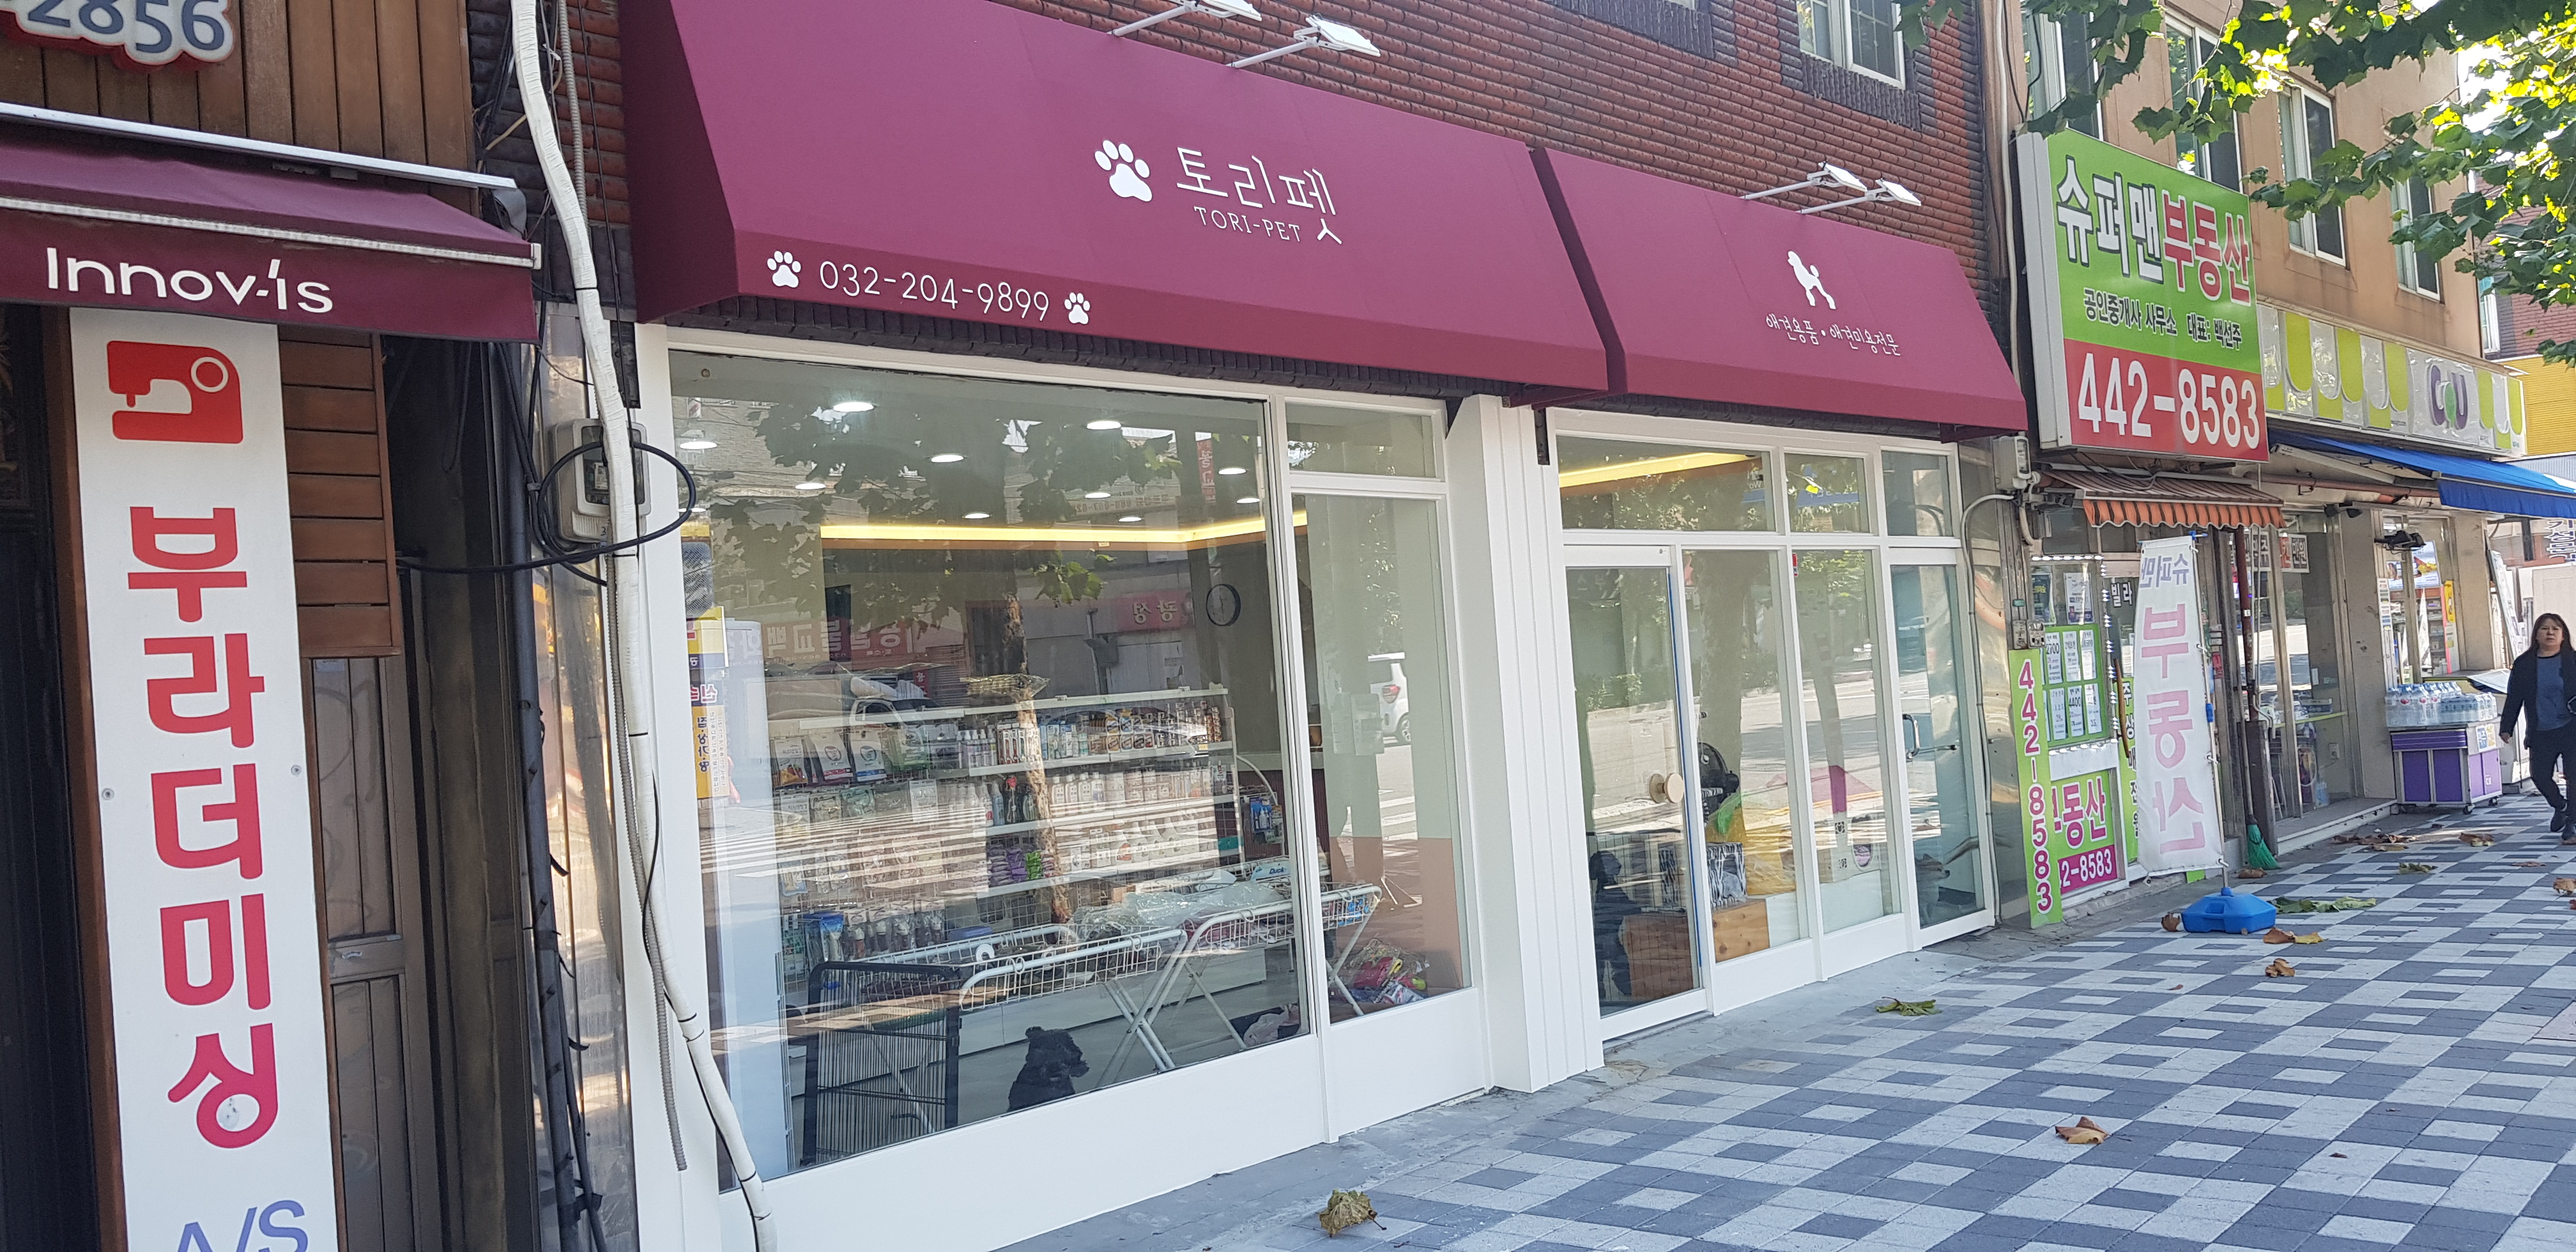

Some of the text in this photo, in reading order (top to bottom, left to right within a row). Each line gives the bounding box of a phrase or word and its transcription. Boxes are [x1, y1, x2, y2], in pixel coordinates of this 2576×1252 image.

[1176, 147, 1342, 245] 토리펫
[1193, 206, 1301, 243] TORI-PET
[820, 261, 1050, 322] 032-204-9899
[2083, 287, 2142, 331] 공인중개사
[2145, 302, 2178, 336] 사무소
[2212, 317, 2242, 351] 백선주
[2078, 353, 2259, 450] 442-8583
[2111, 581, 2133, 607] 빌라
[2018, 659, 2053, 913] 442-8583
[128, 506, 279, 1149] 부라더미싱
[2058, 848, 2112, 889] 2-8583
